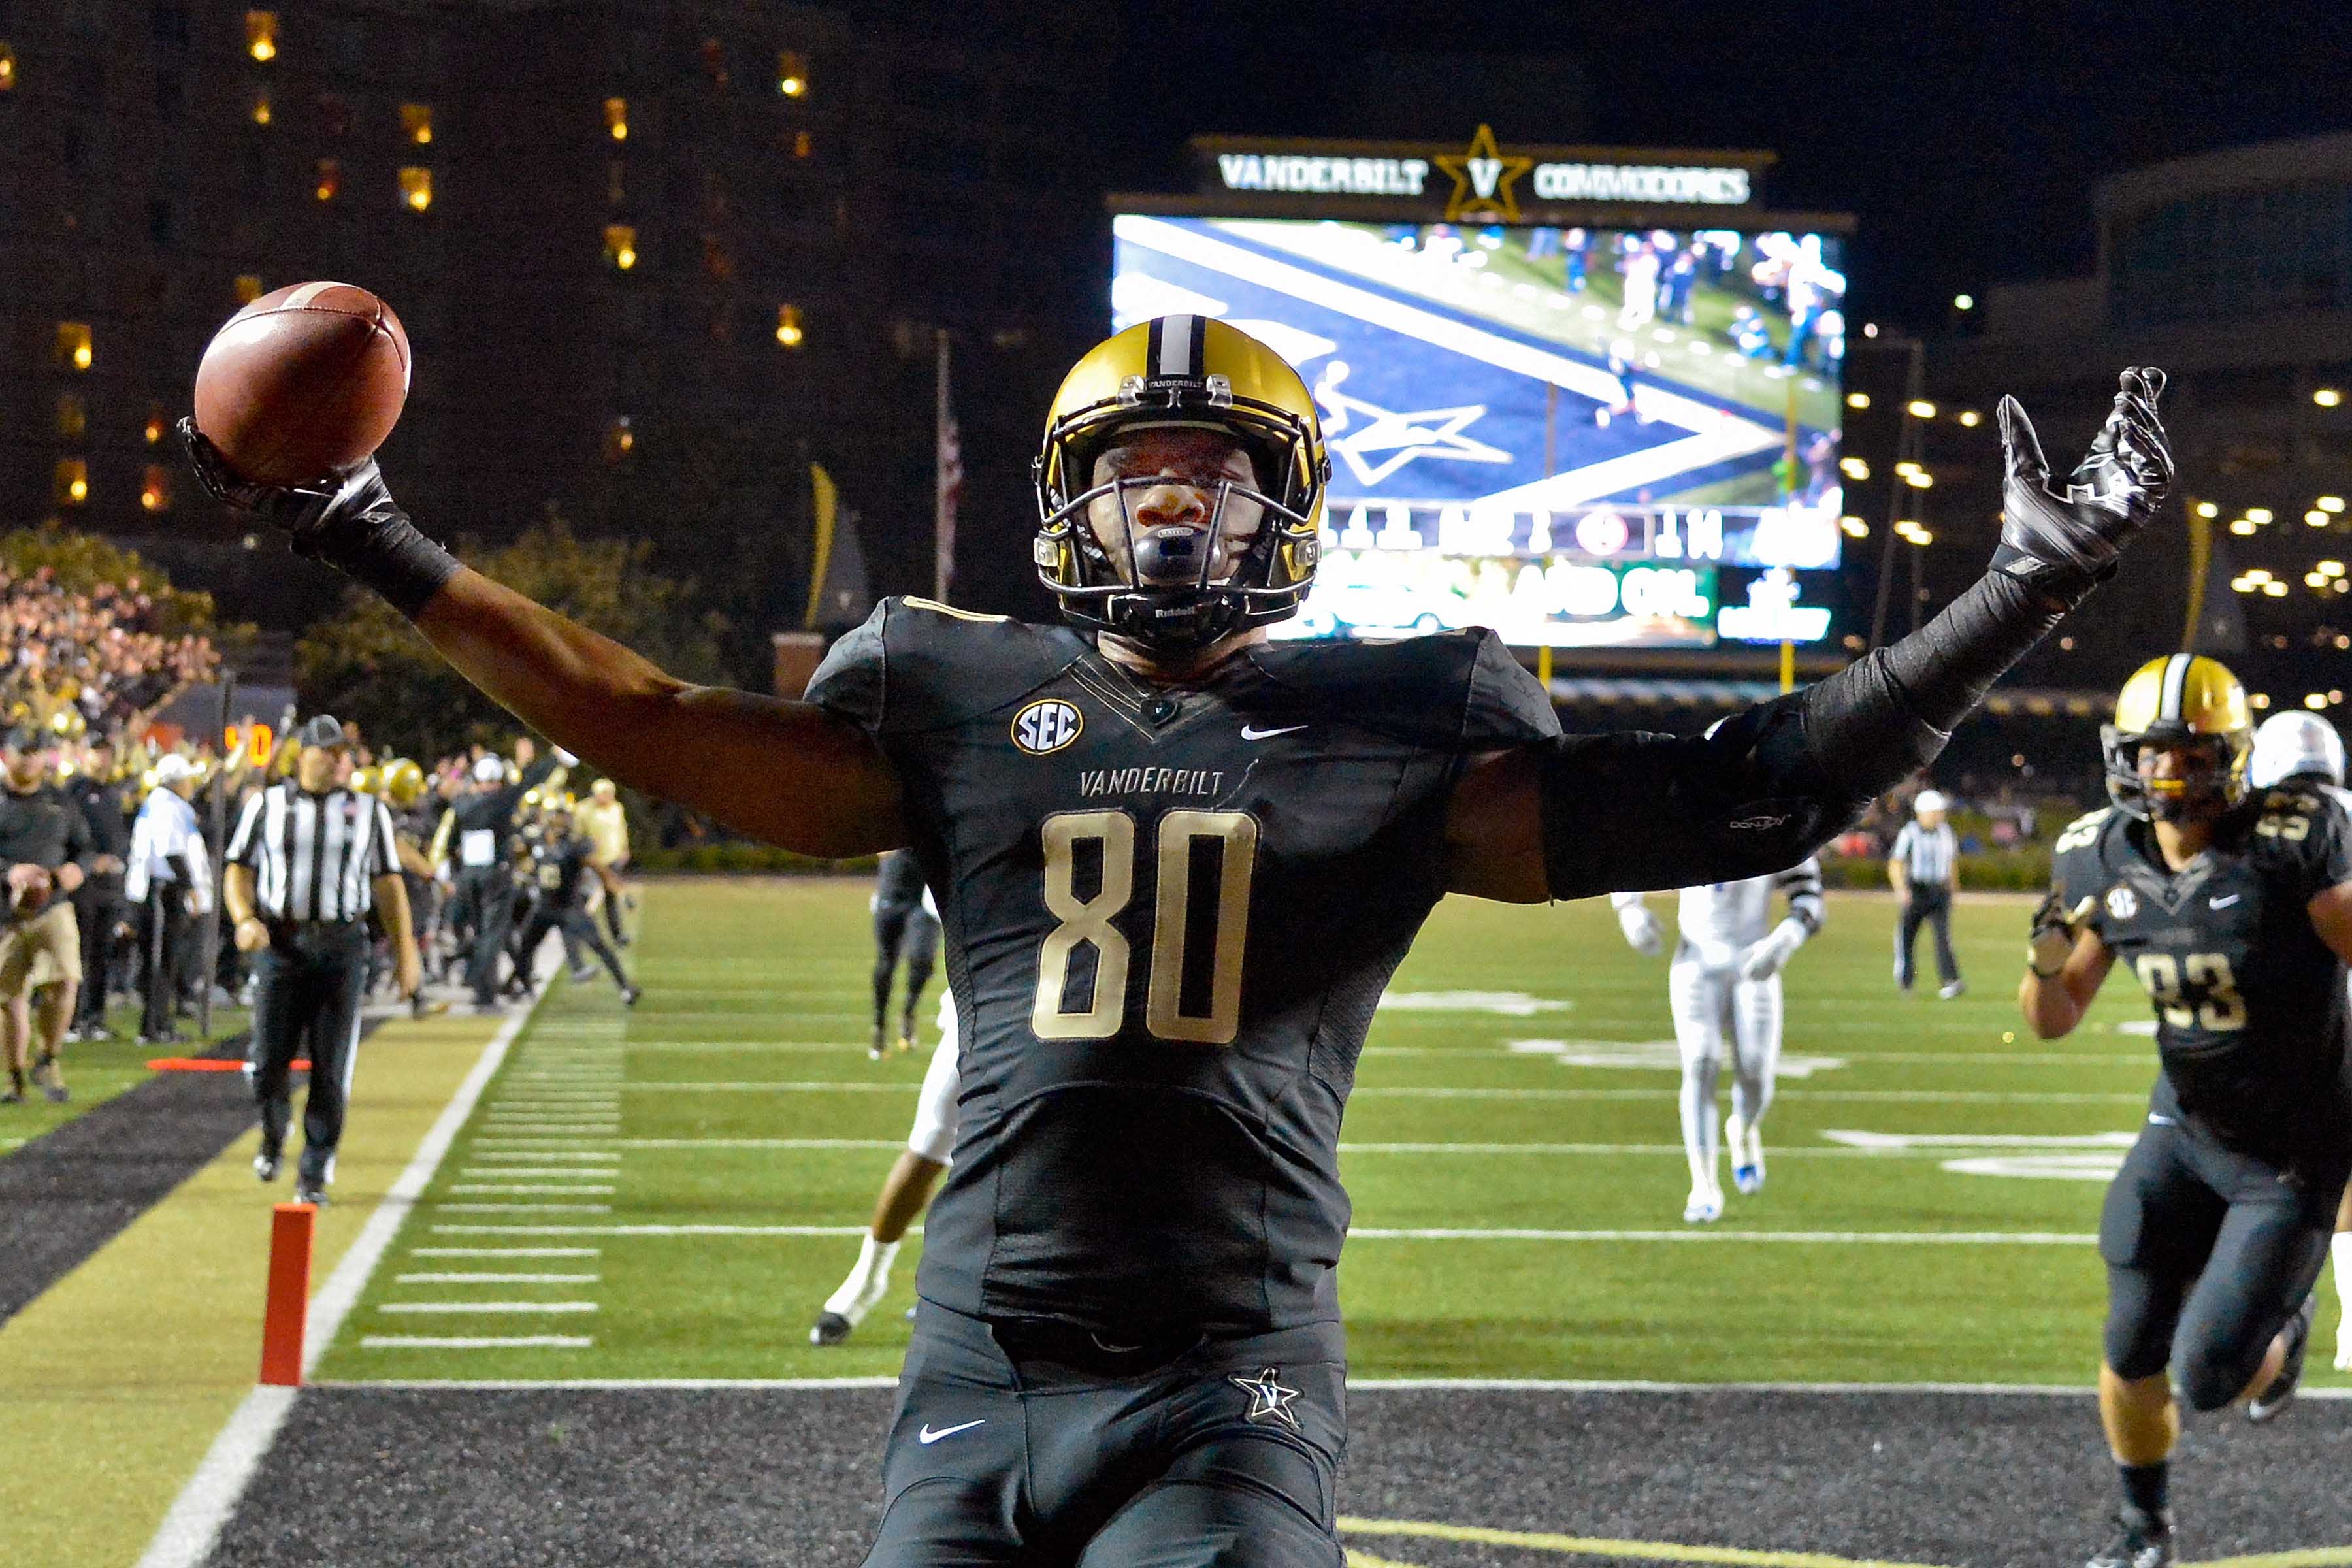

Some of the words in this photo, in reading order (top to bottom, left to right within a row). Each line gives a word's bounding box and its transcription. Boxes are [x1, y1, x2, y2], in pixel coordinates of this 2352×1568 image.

[1219, 155, 1428, 195] VANDERBILT
[1467, 158, 1502, 198] V
[1148, 380, 1203, 388] VANDERBILT
[1155, 606, 1195, 618] Riddell
[1019, 704, 1075, 751] SEC
[1081, 766, 1224, 797] VANDERBILT
[1031, 808, 1261, 1045] 80
[1259, 1384, 1277, 1407] V
